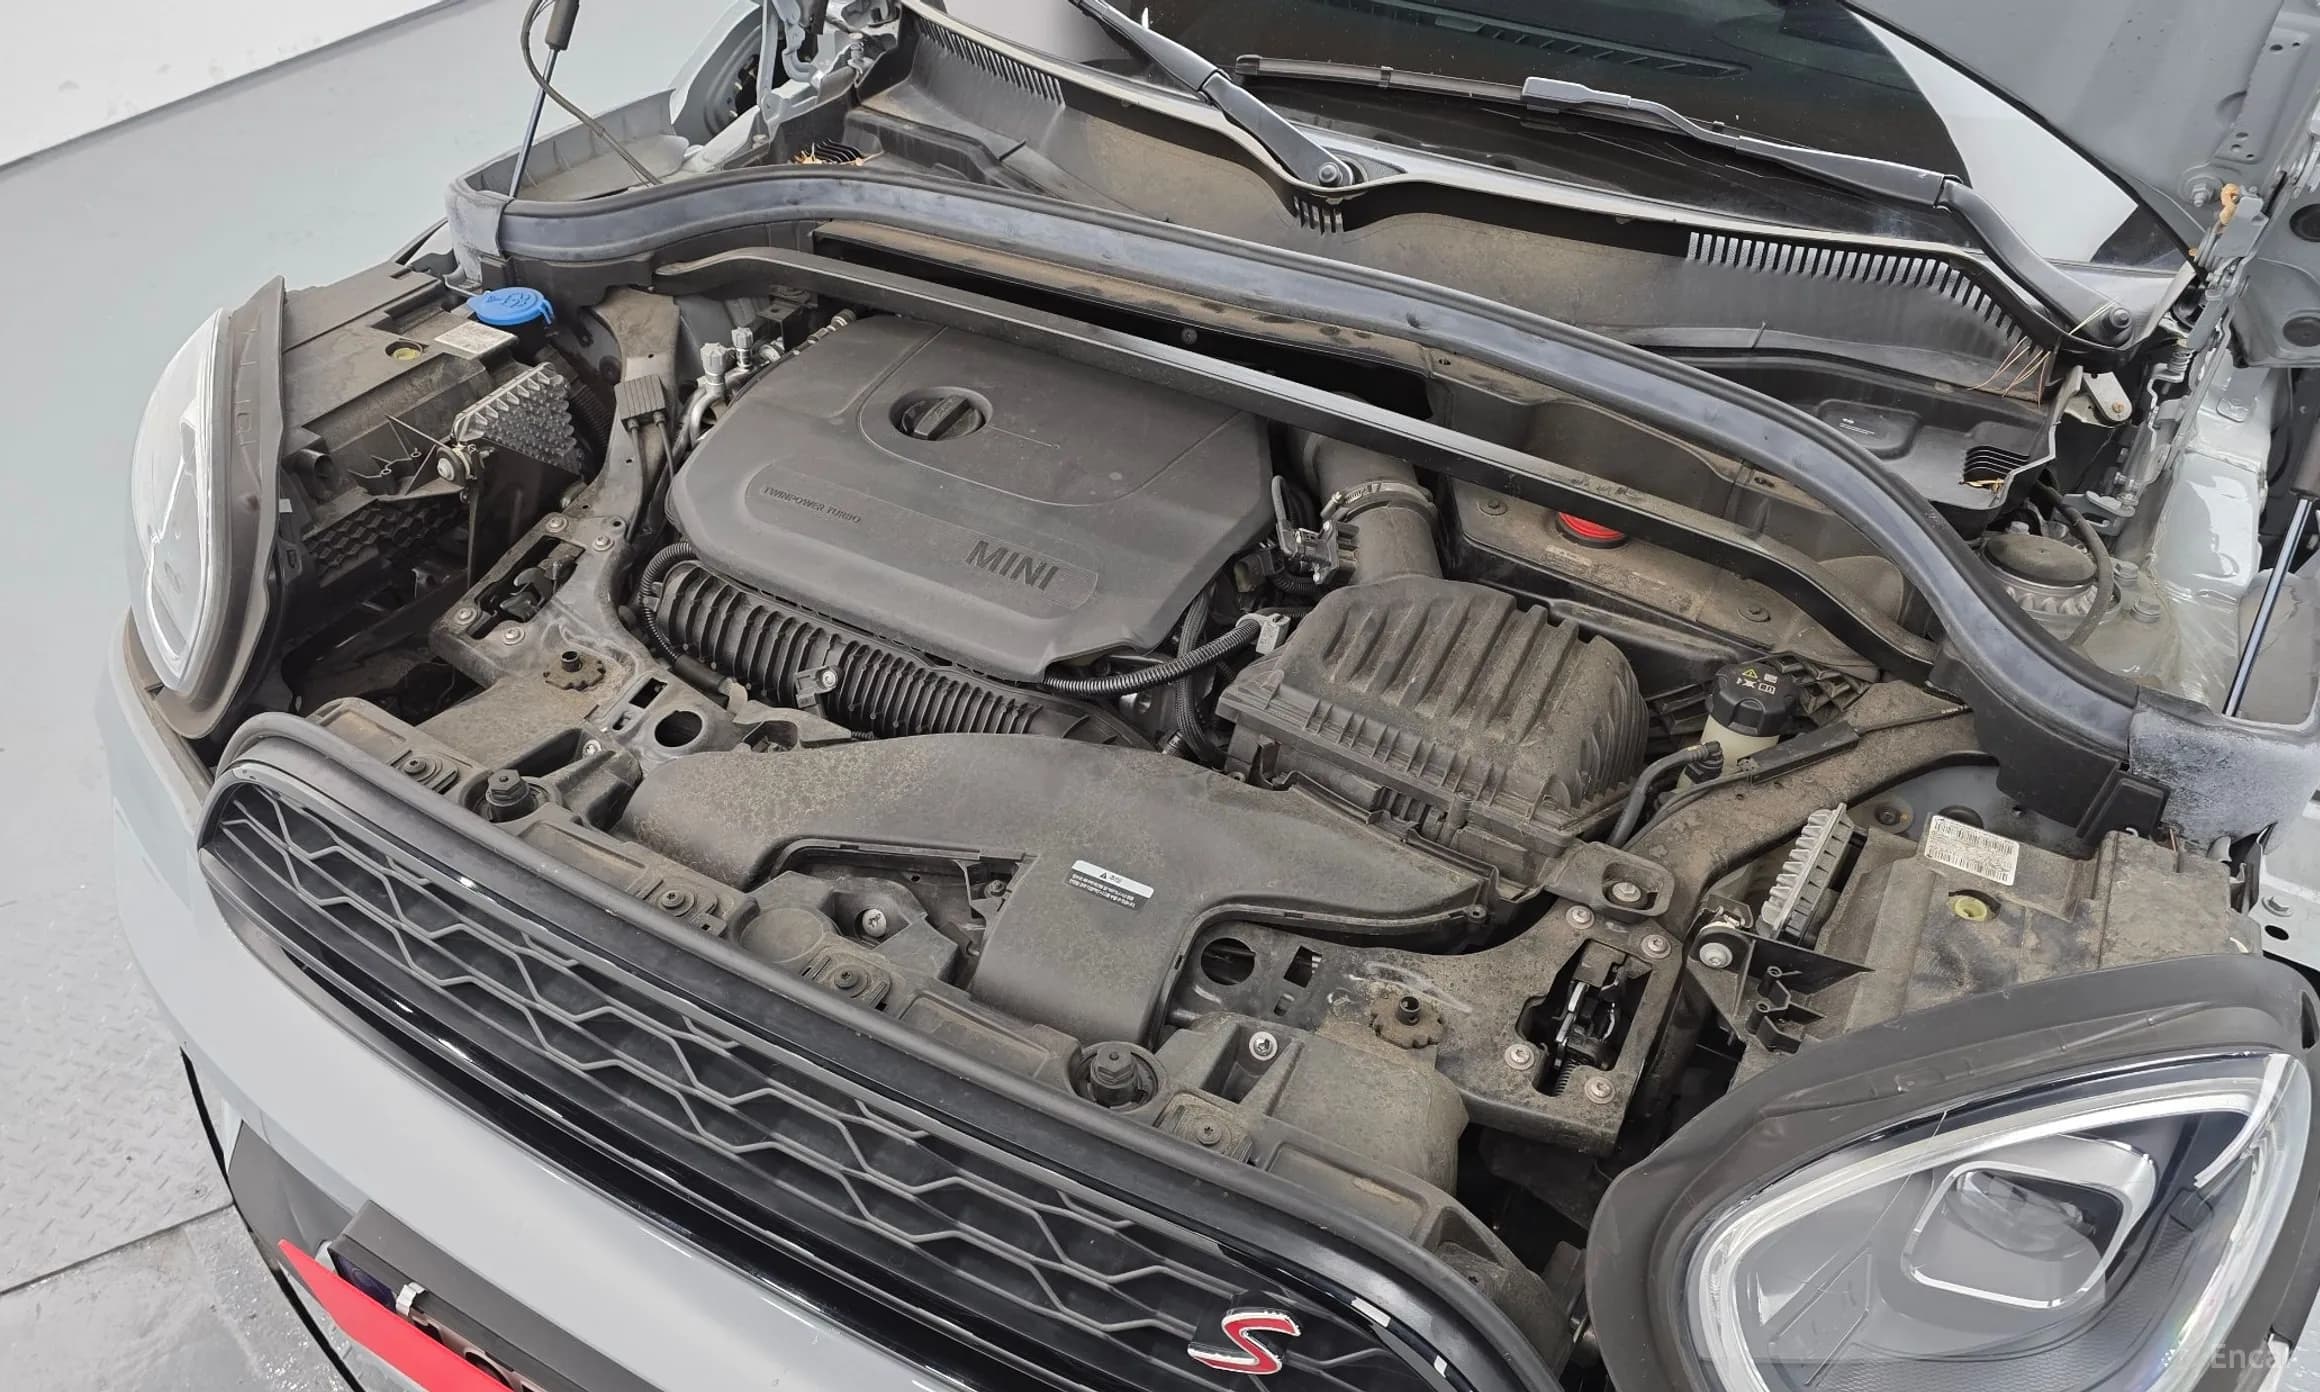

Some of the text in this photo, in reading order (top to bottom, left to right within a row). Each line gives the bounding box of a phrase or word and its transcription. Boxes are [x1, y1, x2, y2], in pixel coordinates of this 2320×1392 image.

[764, 487, 861, 523] TWINPOWER TURBO
[966, 540, 1059, 591] MINI
[1187, 1309, 1301, 1375] S
